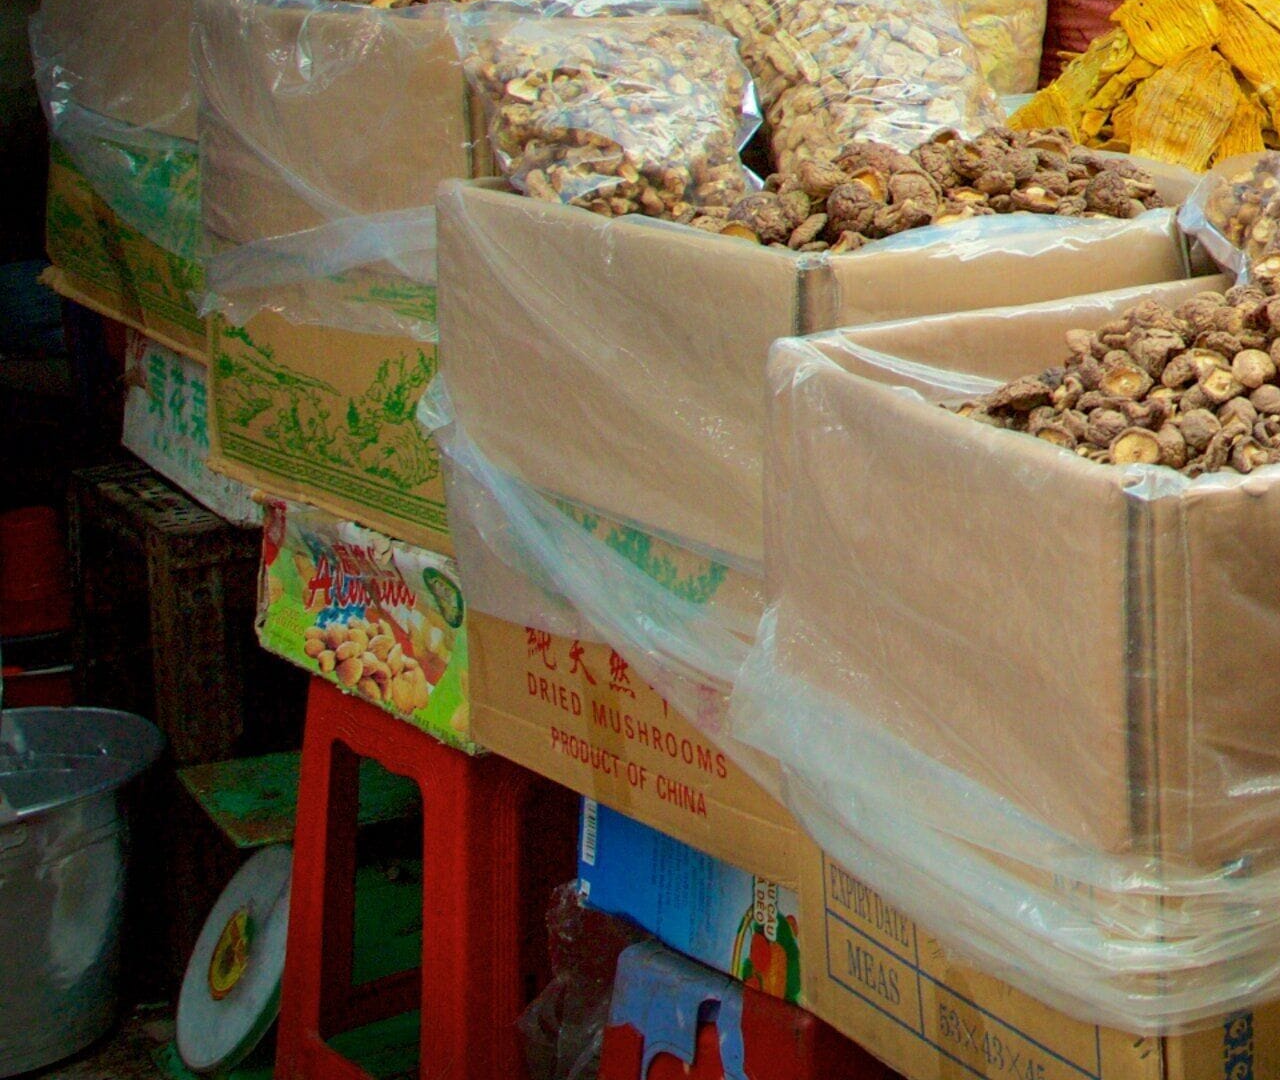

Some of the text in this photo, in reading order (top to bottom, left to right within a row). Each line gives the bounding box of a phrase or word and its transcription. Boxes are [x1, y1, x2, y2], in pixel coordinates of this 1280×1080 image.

[527, 671, 728, 779] DRIED MUSHROOMS
[551, 726, 707, 819] PRODUCT OF CHINA
[846, 939, 900, 1006] MEAS
